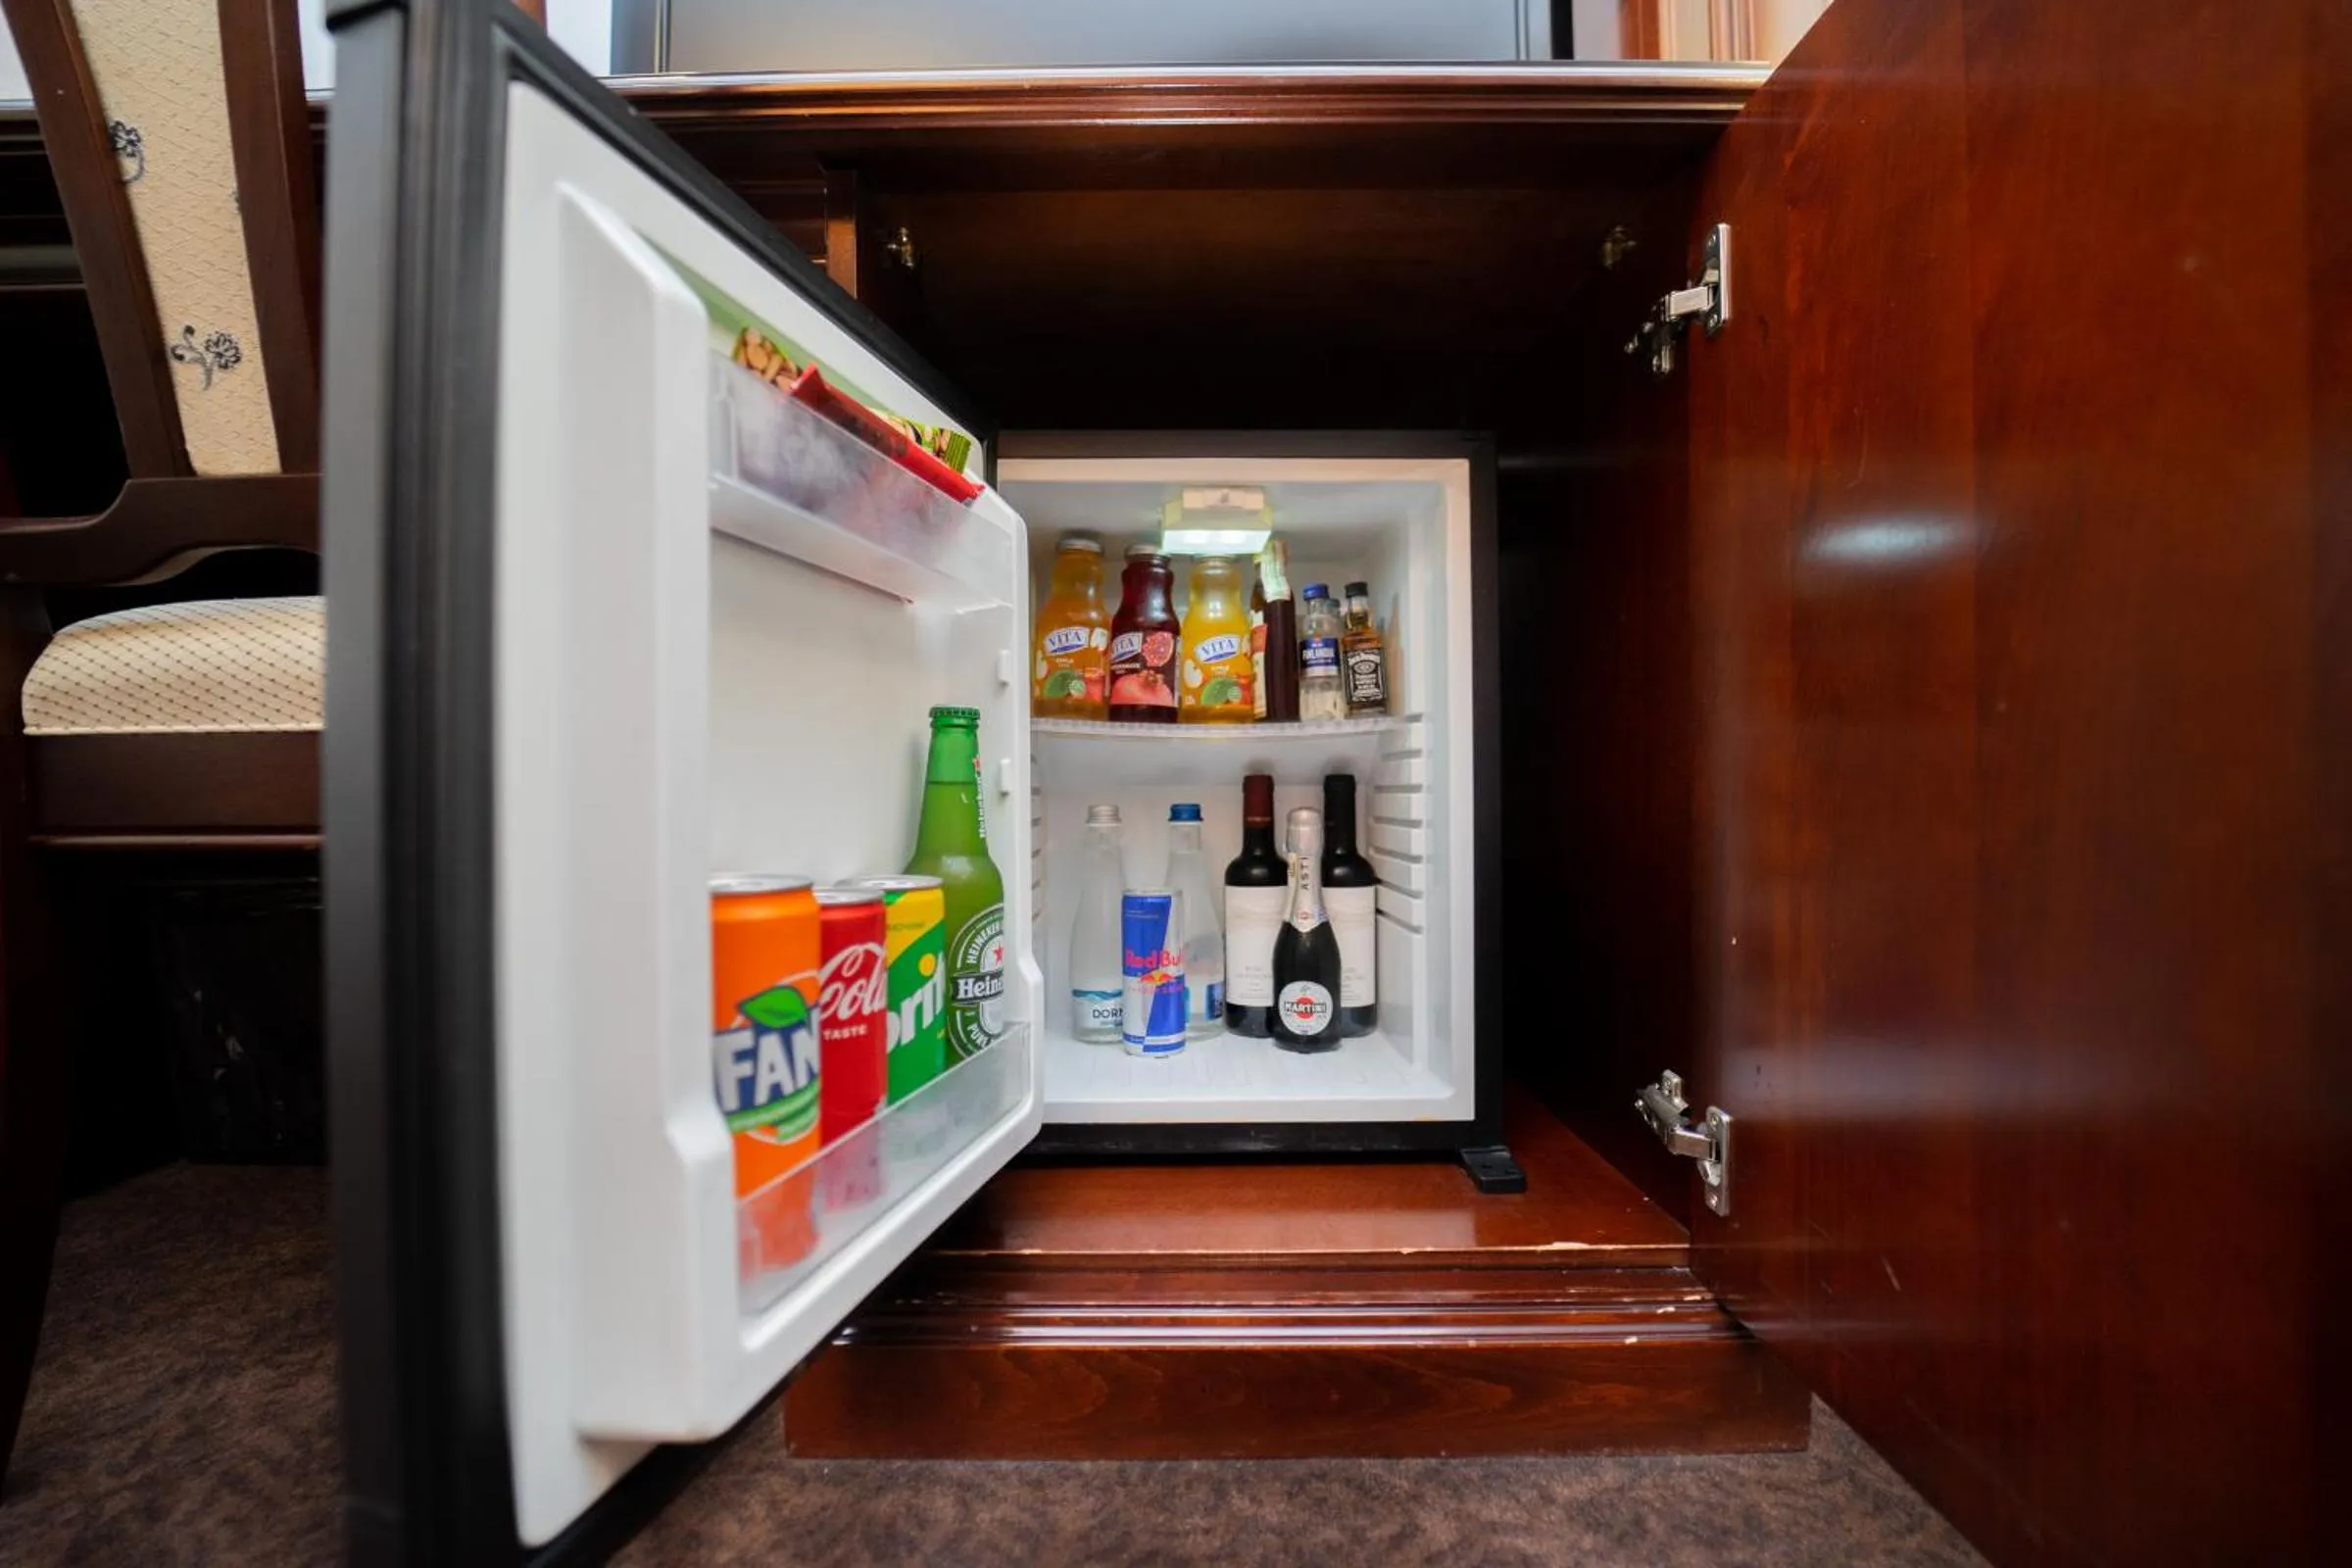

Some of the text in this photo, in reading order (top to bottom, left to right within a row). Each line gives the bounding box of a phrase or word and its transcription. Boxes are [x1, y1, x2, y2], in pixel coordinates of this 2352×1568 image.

[1048, 630, 1083, 647] VITA
[1201, 638, 1236, 656] VITA
[1125, 949, 1158, 969] Red
[822, 1024, 867, 1041] TASTE
